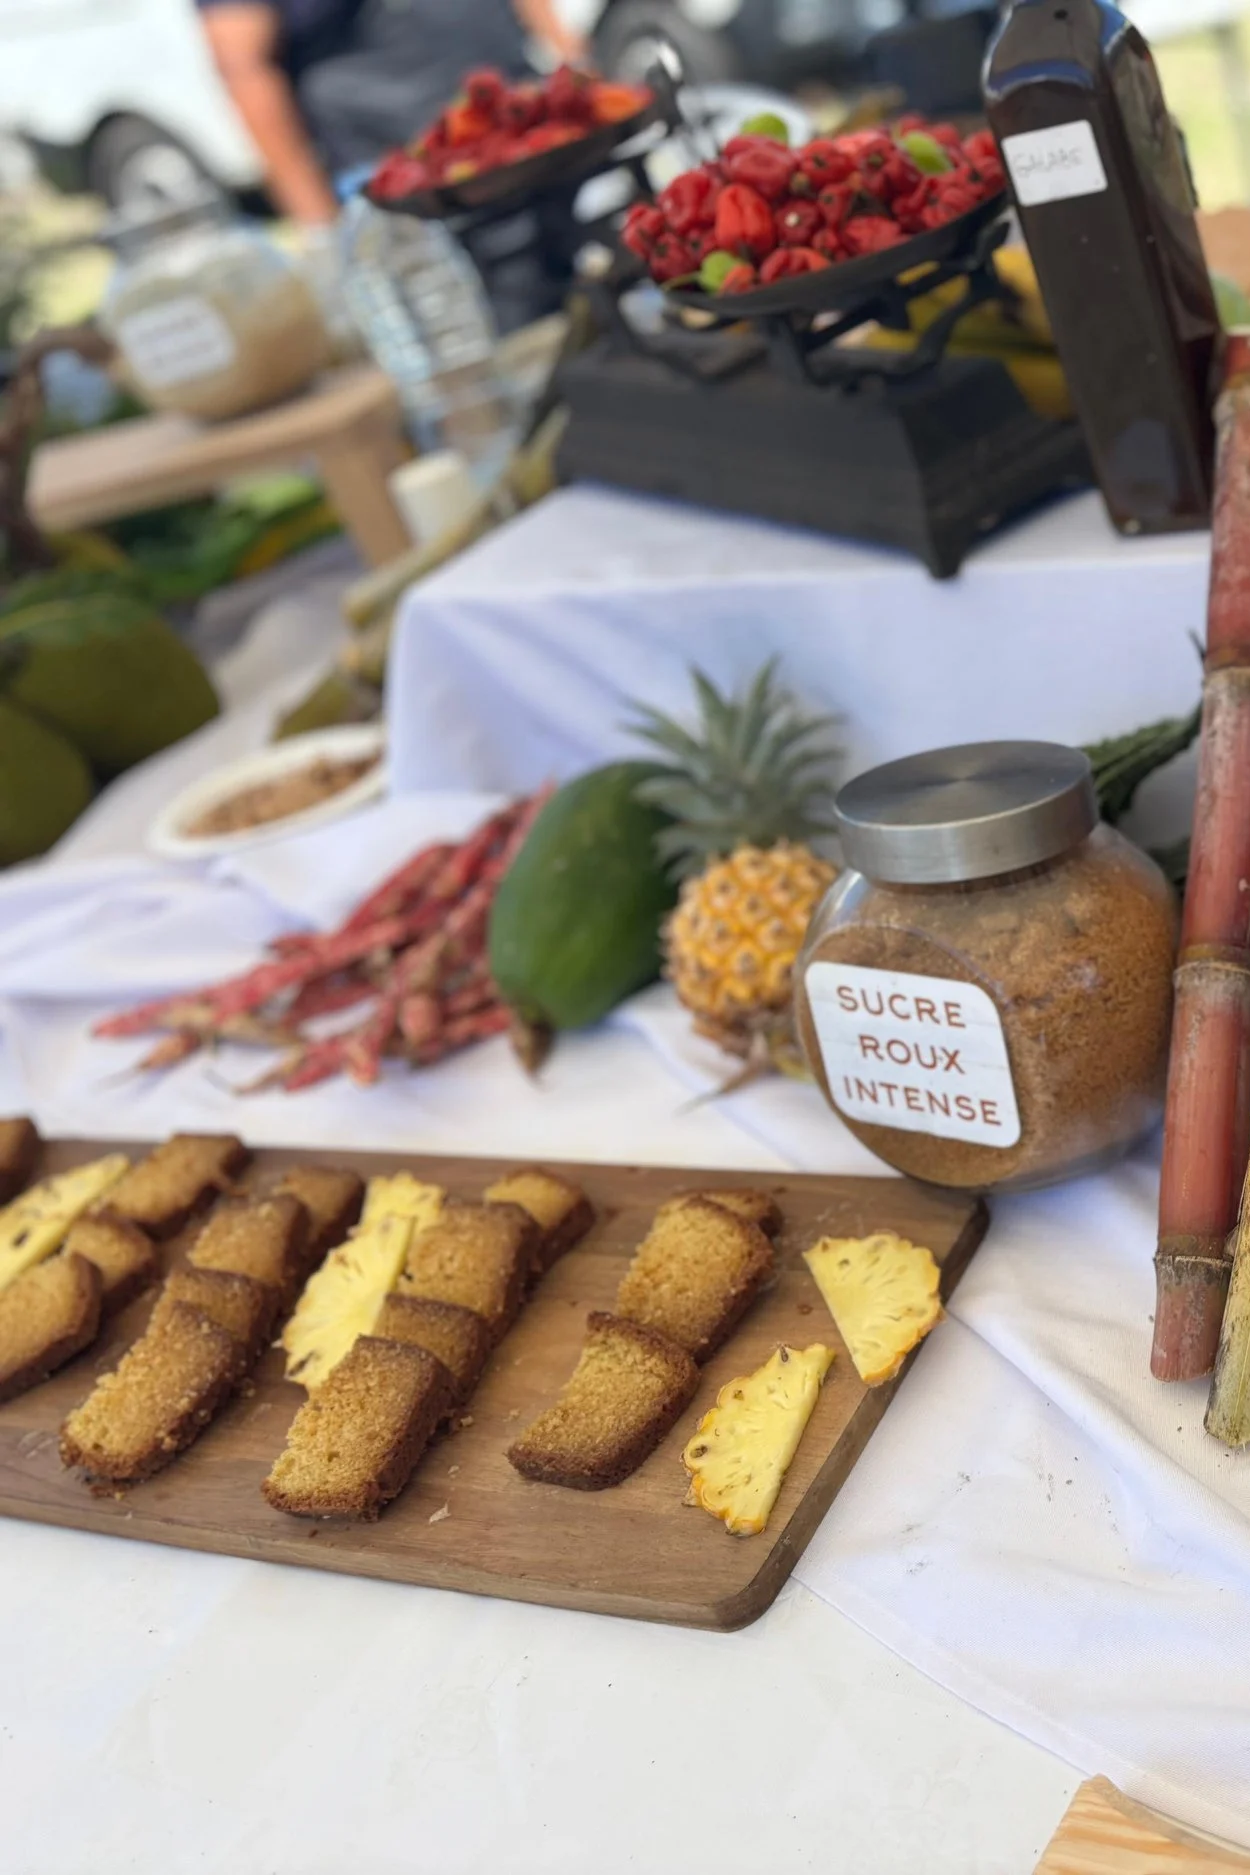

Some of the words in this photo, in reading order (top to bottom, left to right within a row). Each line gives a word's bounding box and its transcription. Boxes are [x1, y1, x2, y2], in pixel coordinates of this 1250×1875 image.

[837, 986, 966, 1028] SUCRE
[858, 1034, 965, 1074] ROUX
[843, 1076, 1002, 1126] INTENSE
